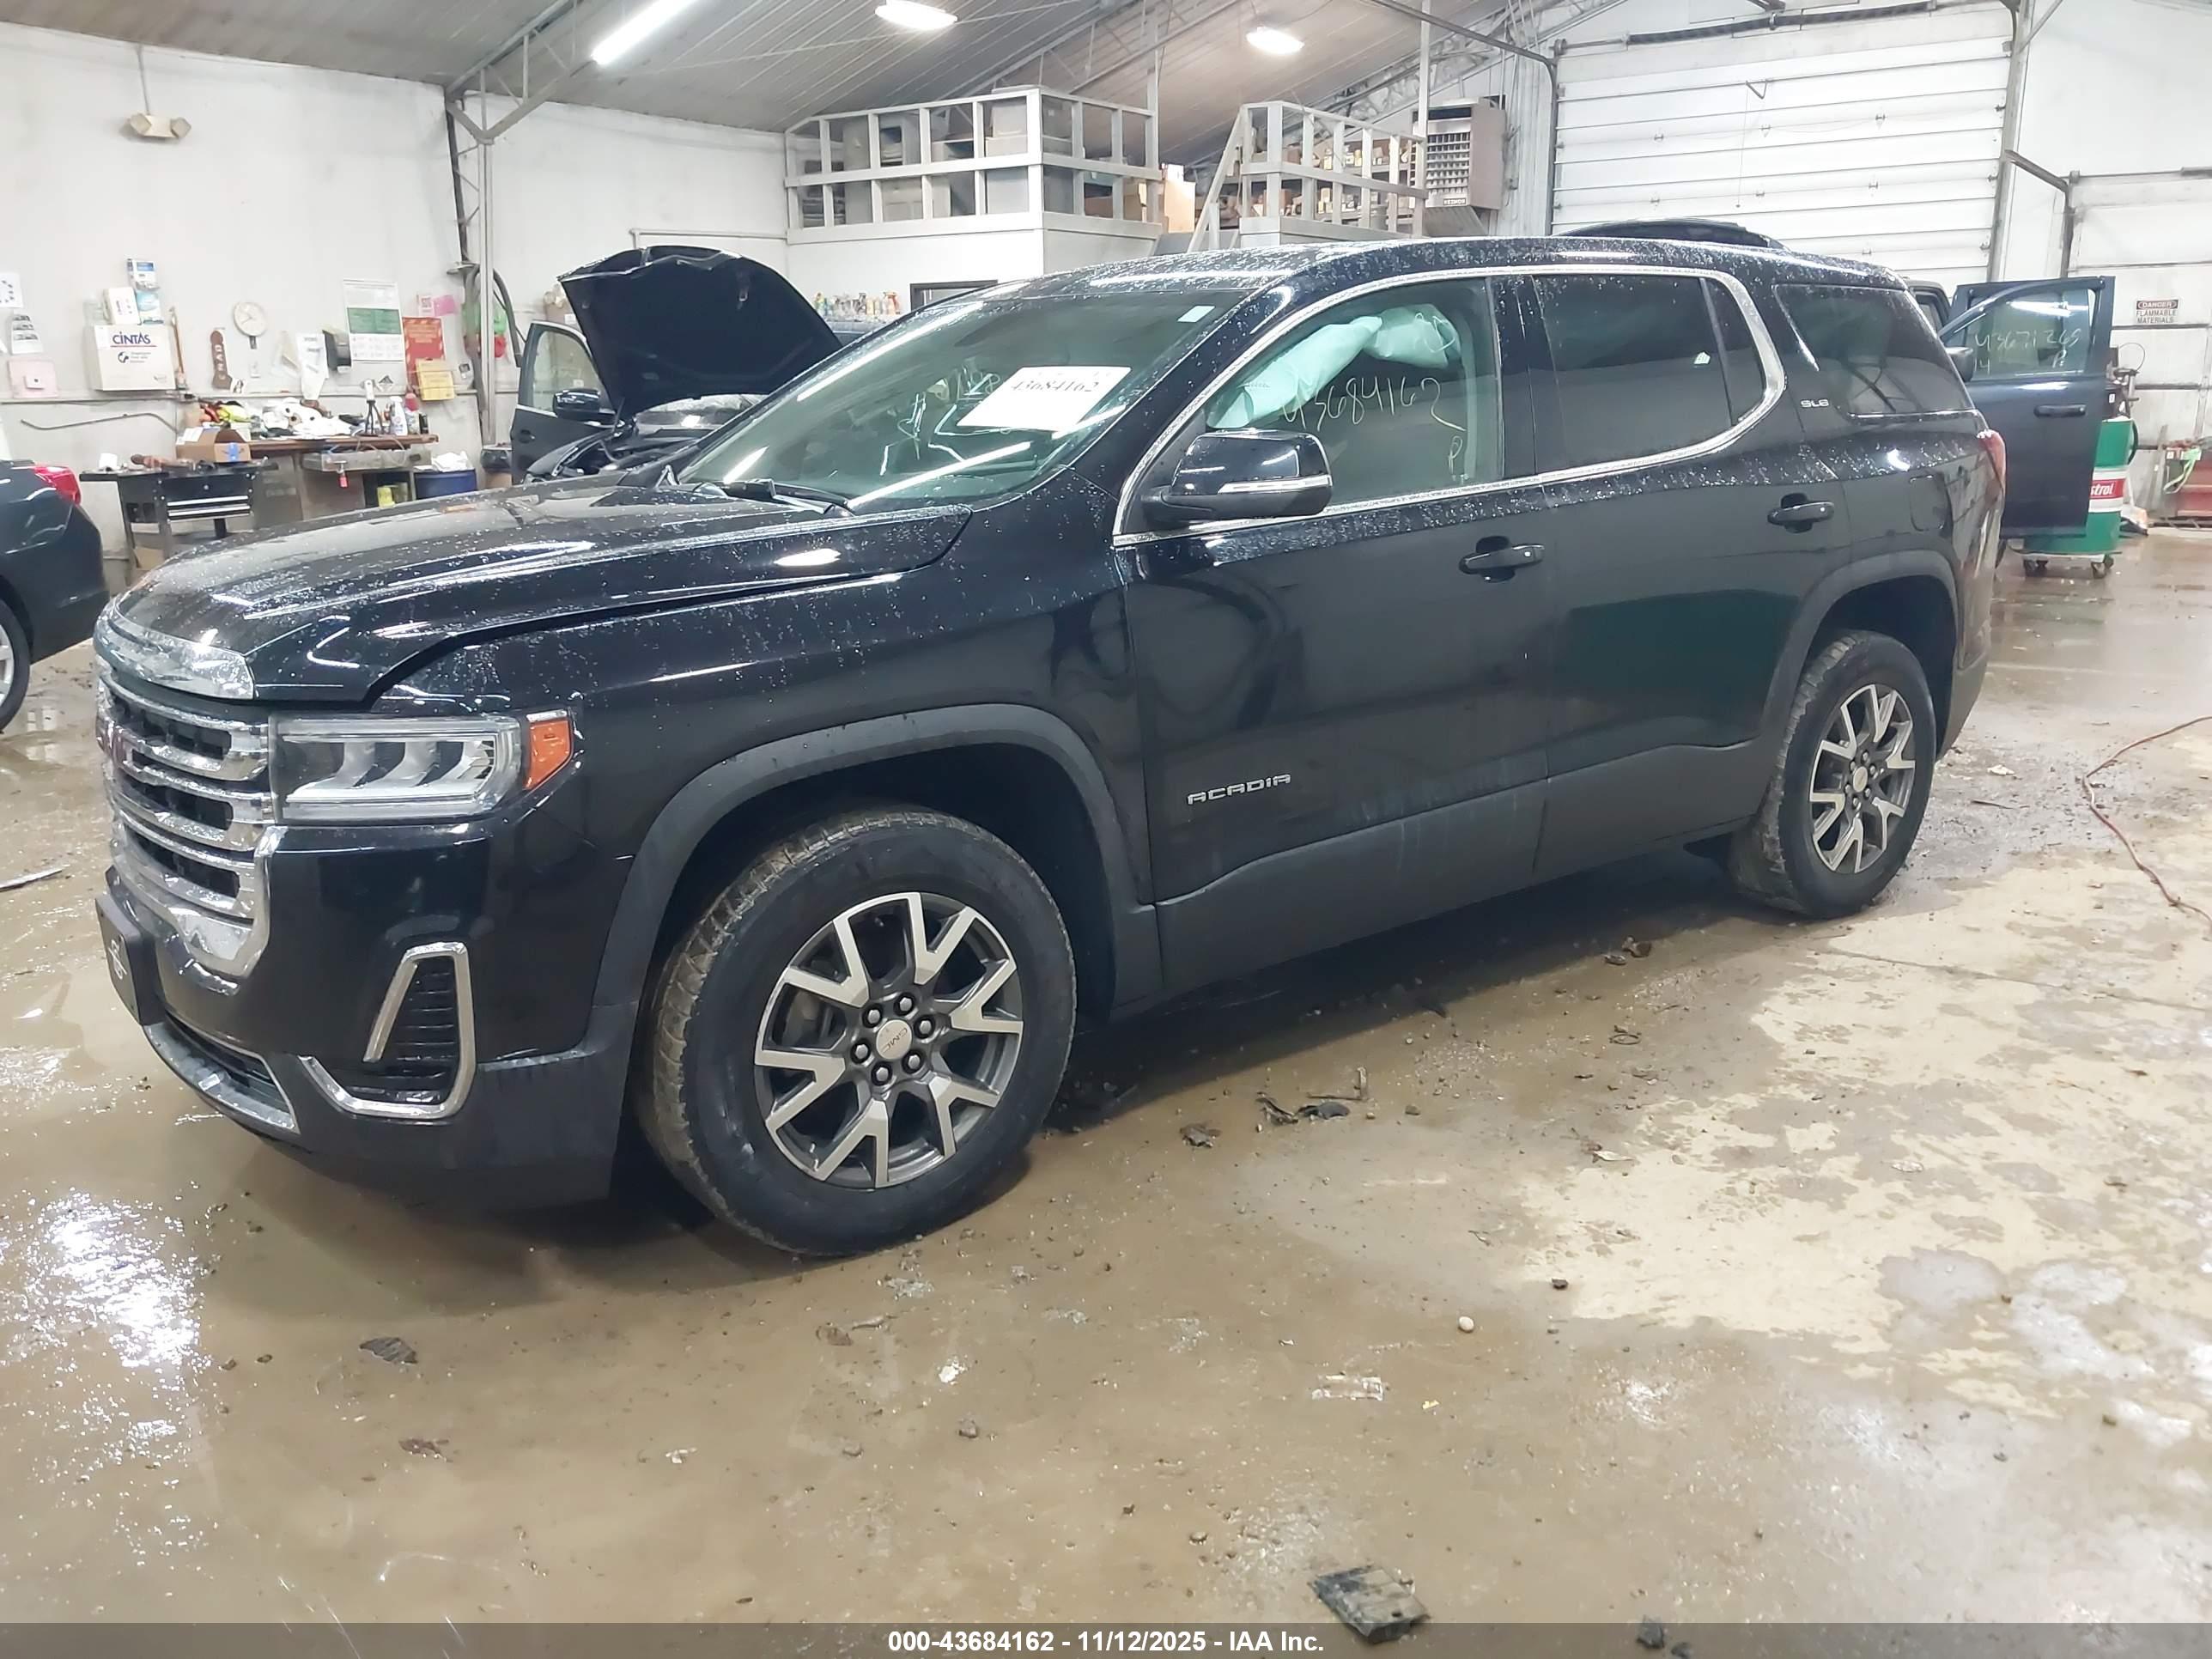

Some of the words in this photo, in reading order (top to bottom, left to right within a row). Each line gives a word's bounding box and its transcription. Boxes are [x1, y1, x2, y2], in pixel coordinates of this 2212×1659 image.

[112, 331, 151, 344] CINTAS
[2090, 483, 2114, 495] strol
[1187, 774, 1291, 805] ACADIA
[882, 1027, 908, 1054] GMC
